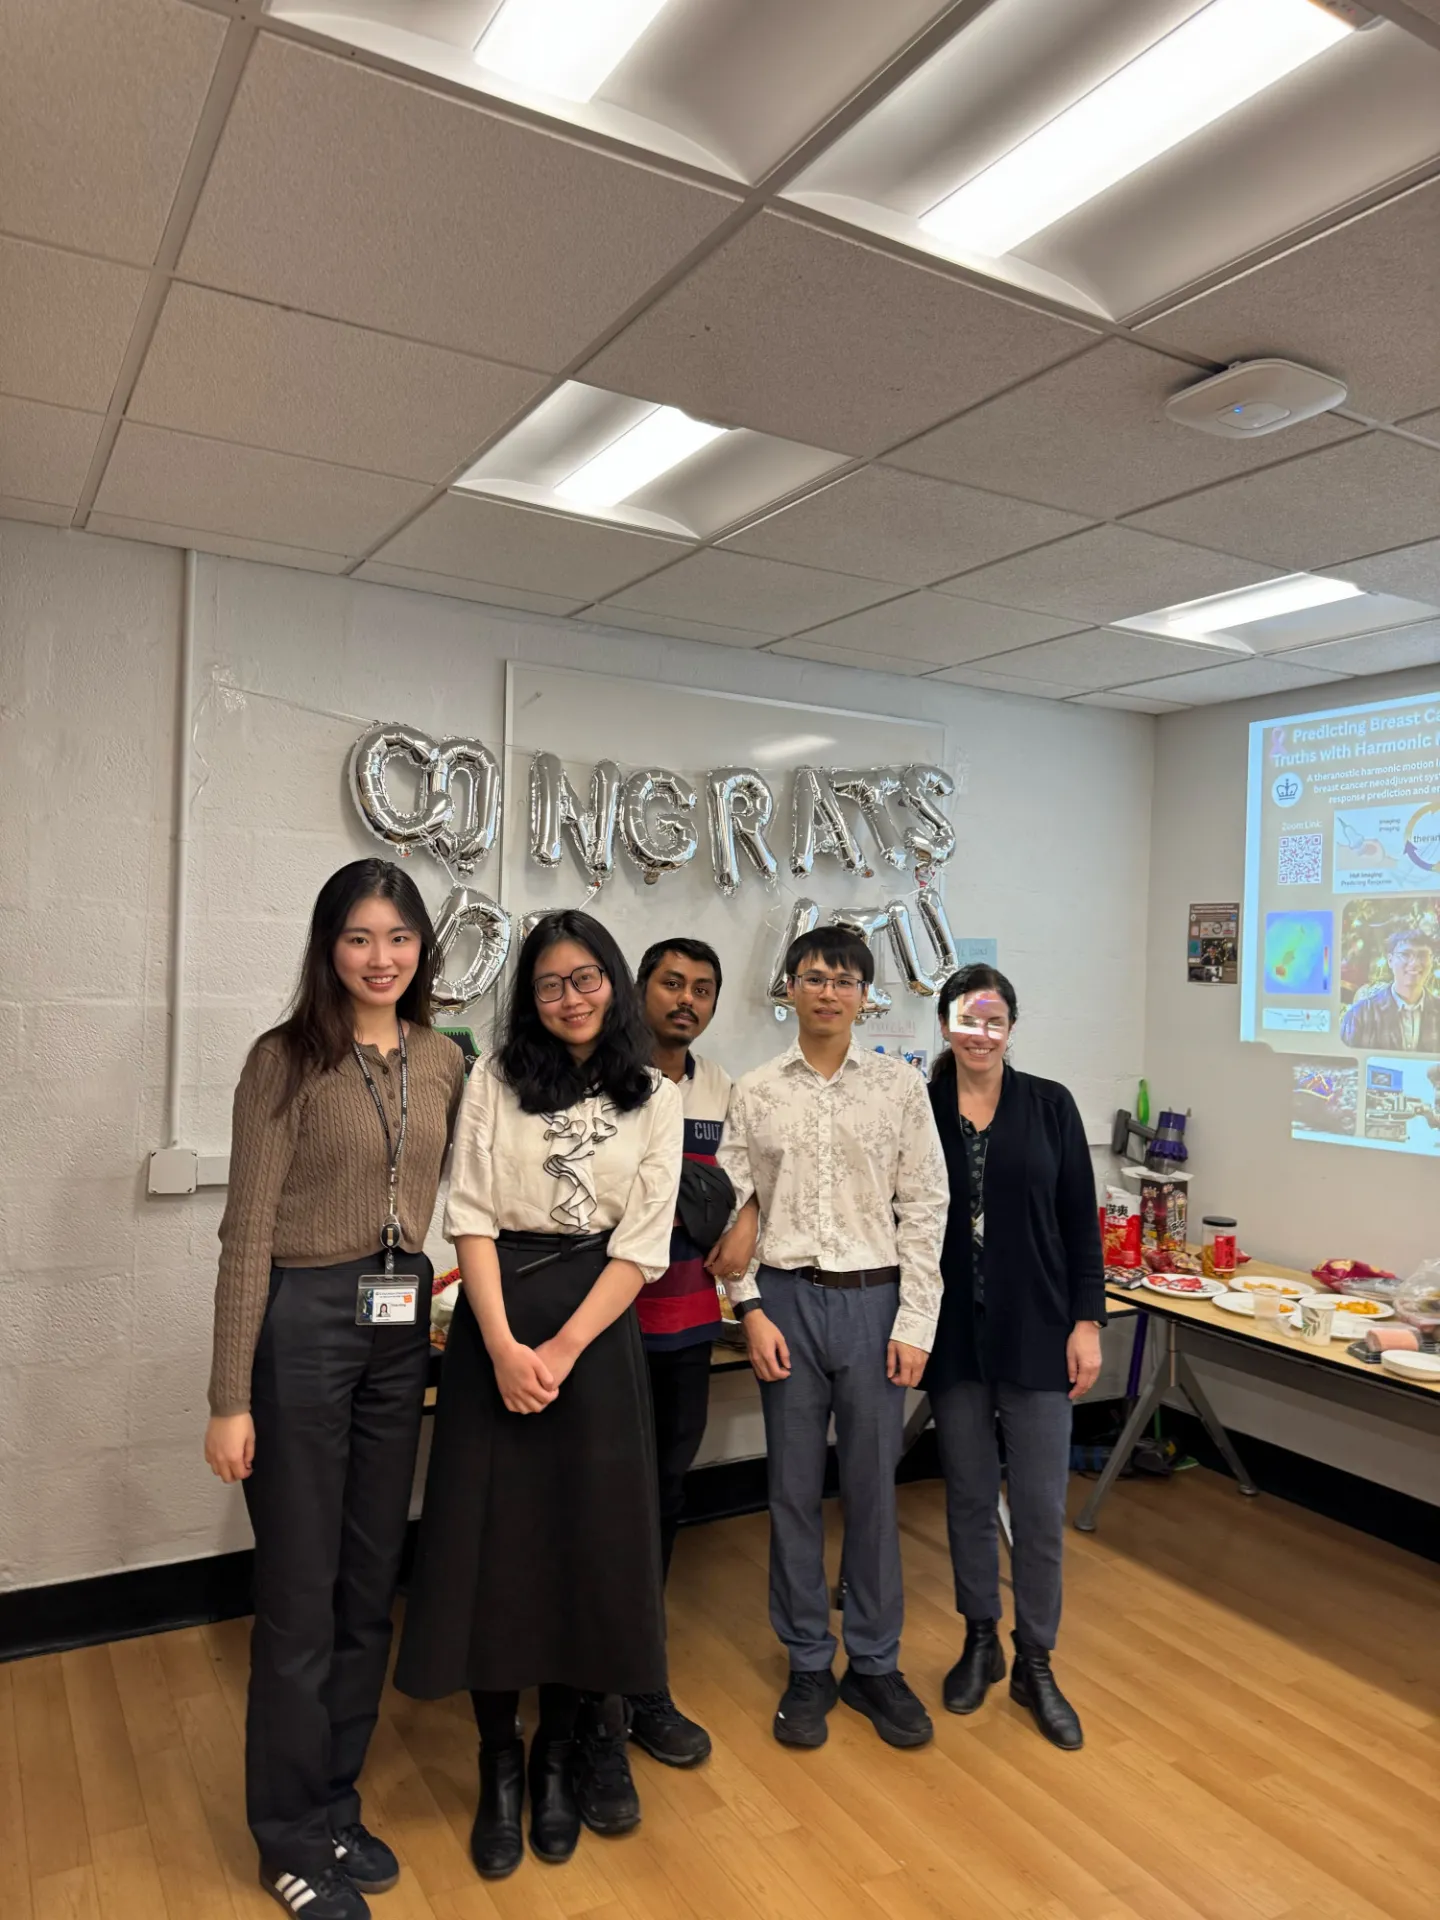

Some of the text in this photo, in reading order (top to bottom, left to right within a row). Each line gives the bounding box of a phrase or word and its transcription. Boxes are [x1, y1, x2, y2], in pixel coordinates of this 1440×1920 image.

[1293, 720, 1366, 743] Predicting
[1370, 712, 1421, 731] Breast
[1272, 749, 1317, 767] Truths
[1320, 743, 1351, 761] with
[1355, 733, 1432, 757] Harmonic
[1314, 768, 1360, 781] theranostic
[1361, 764, 1402, 776] harmonic
[1402, 760, 1434, 772] motion
[1313, 783, 1339, 794] breast
[1340, 780, 1368, 791] cancer
[1369, 774, 1423, 788] neoadjuvant
[1329, 793, 1365, 804] response
[1367, 788, 1411, 802] prediction
[1412, 785, 1430, 795] and
[1281, 821, 1305, 831] Zoom
